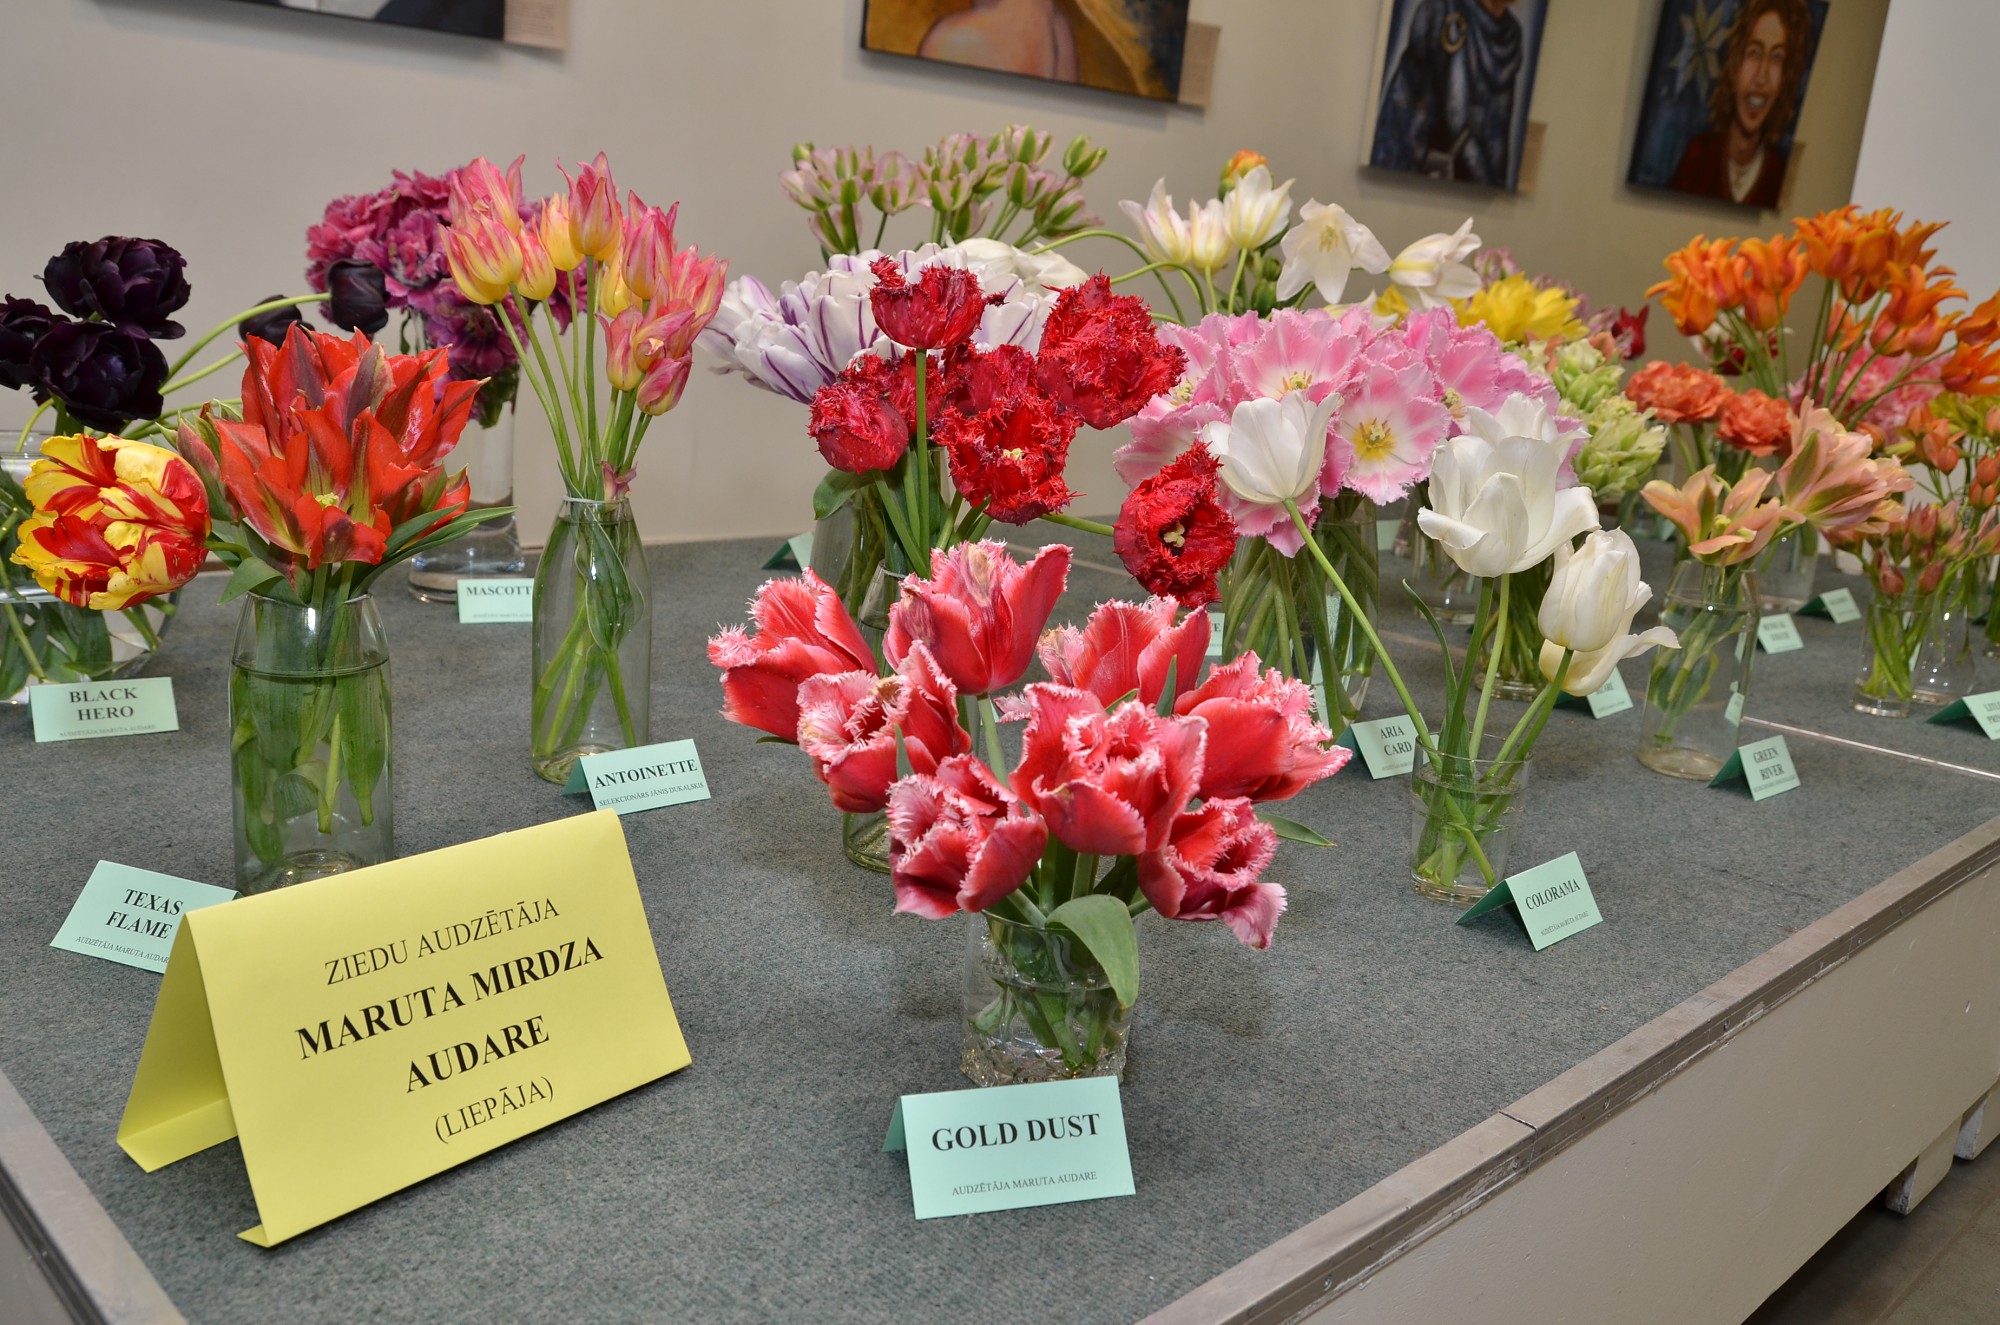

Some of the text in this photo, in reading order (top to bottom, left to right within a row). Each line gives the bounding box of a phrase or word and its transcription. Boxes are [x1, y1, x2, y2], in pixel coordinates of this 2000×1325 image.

[69, 687, 138, 703] BLACK
[78, 705, 135, 721] HERO
[1380, 725, 1405, 739] ARIA
[1384, 741, 1413, 756] CARD
[595, 759, 698, 789] ANTOINETTE
[1759, 764, 1785, 781] RIVER
[599, 790, 650, 806] SELEKCIONĀRS
[650, 787, 669, 797] JĀNIS
[123, 888, 184, 916] TEXAS
[1525, 878, 1581, 910] COLORAMA
[105, 910, 173, 940] FLAME
[75, 935, 114, 951] AUDZĒTĀJA
[114, 944, 144, 958] MARUTA
[324, 897, 560, 986] ZIEDU AUDZĒTĀJA
[294, 935, 605, 1061] MARUTA MIRDZA
[406, 1014, 550, 1094] AUDARE
[434, 1076, 554, 1144] (LIEPĀJA)
[931, 1113, 1101, 1152] GOLD DUST
[952, 1171, 1098, 1196] AUDZĒTĀJA MARUTA AUDARE
